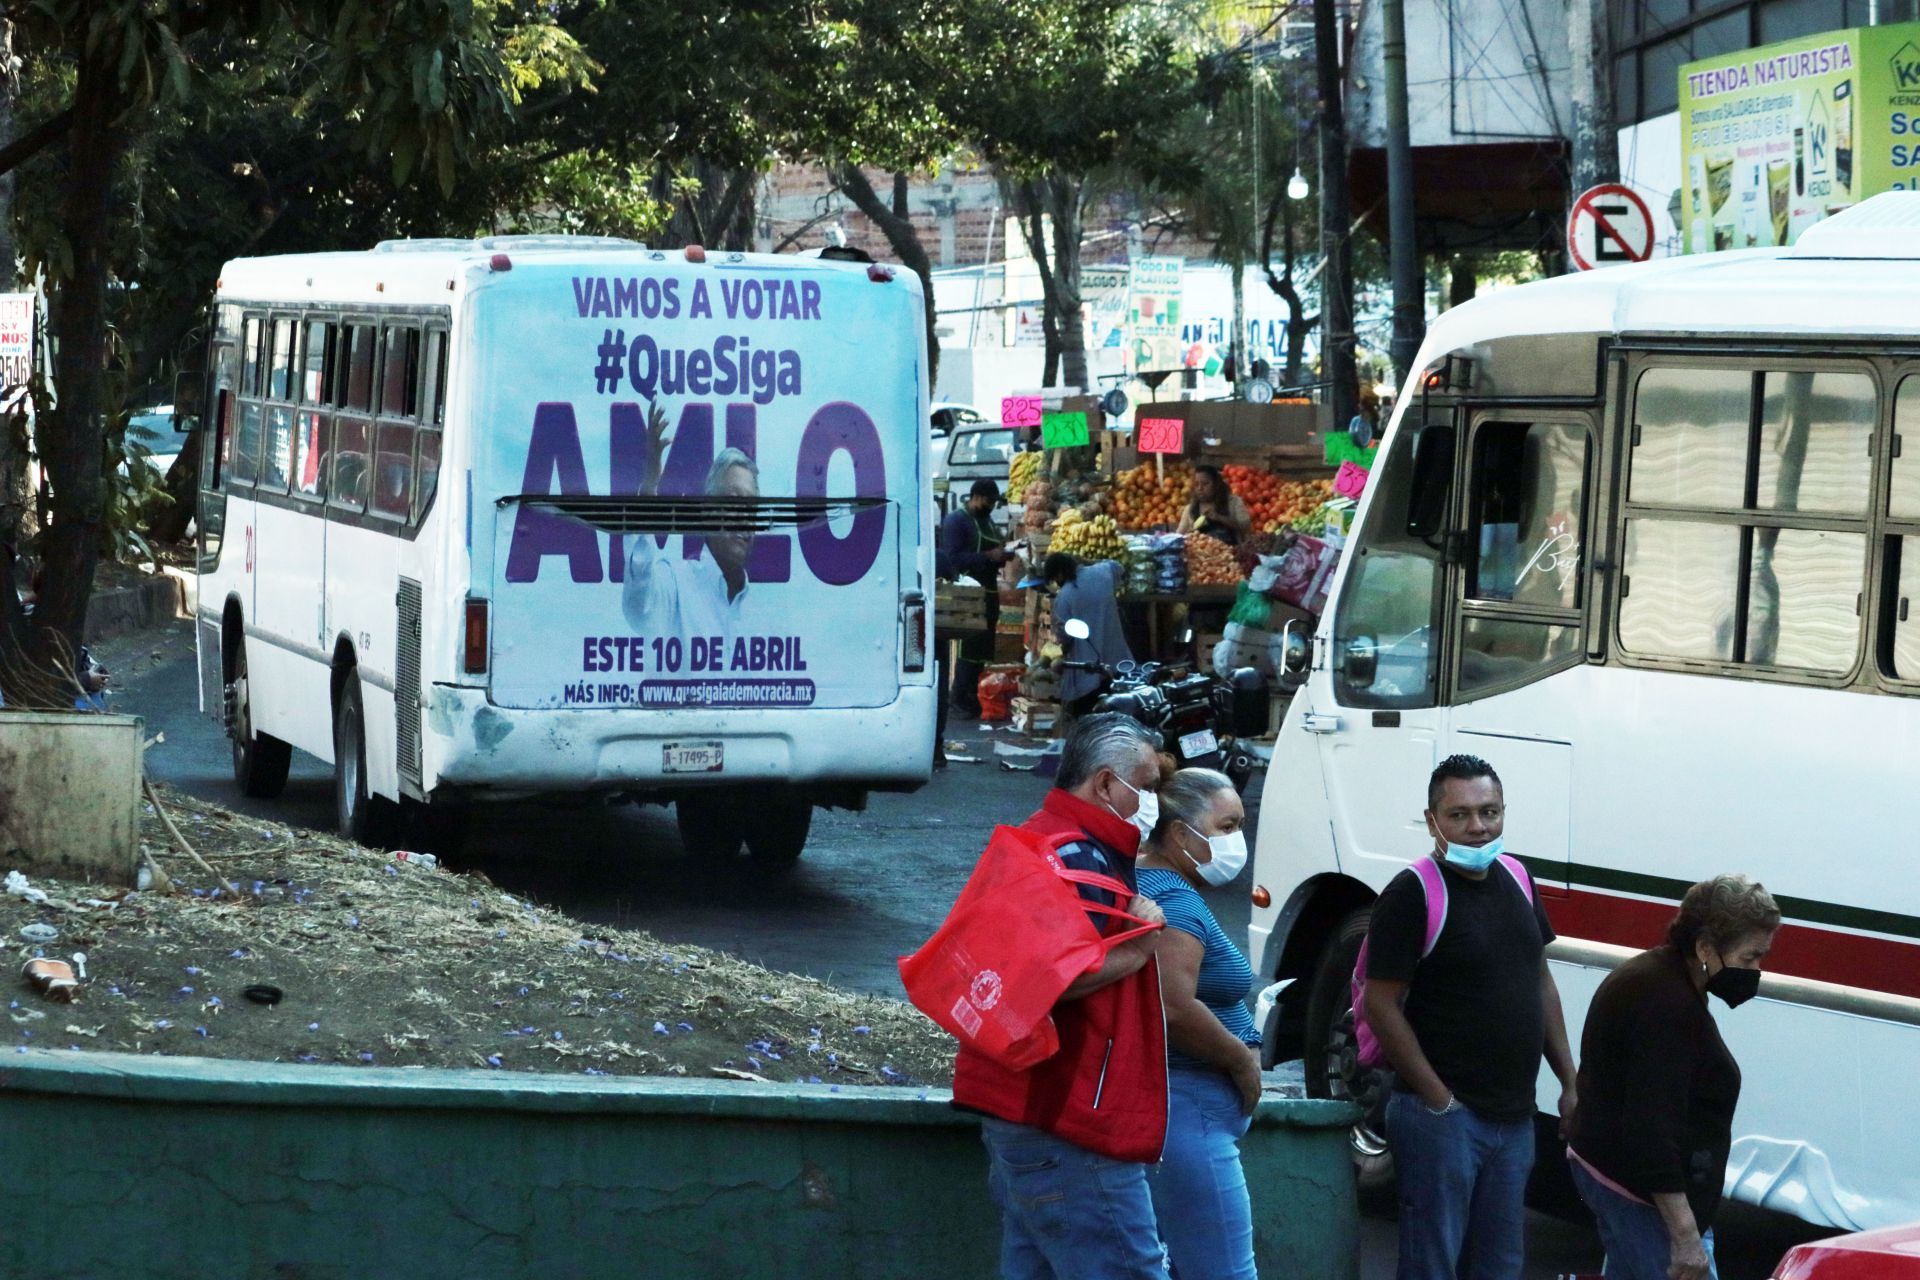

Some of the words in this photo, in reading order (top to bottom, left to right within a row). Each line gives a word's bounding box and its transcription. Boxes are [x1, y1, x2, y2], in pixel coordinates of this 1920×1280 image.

[1688, 64, 1750, 98] TIENDA
[1754, 43, 1852, 84] NATURISTA
[572, 276, 680, 319] VAMOS
[690, 278, 714, 319] A
[720, 278, 821, 321] VOTAR
[594, 328, 802, 405] #QueSiga
[505, 401, 887, 586] AMLO
[583, 636, 644, 672] ESTE
[651, 636, 683, 673] 10
[690, 636, 723, 672] DE
[730, 636, 807, 671] ABRIL
[564, 679, 594, 703] MÁS
[598, 684, 635, 703] INFO:
